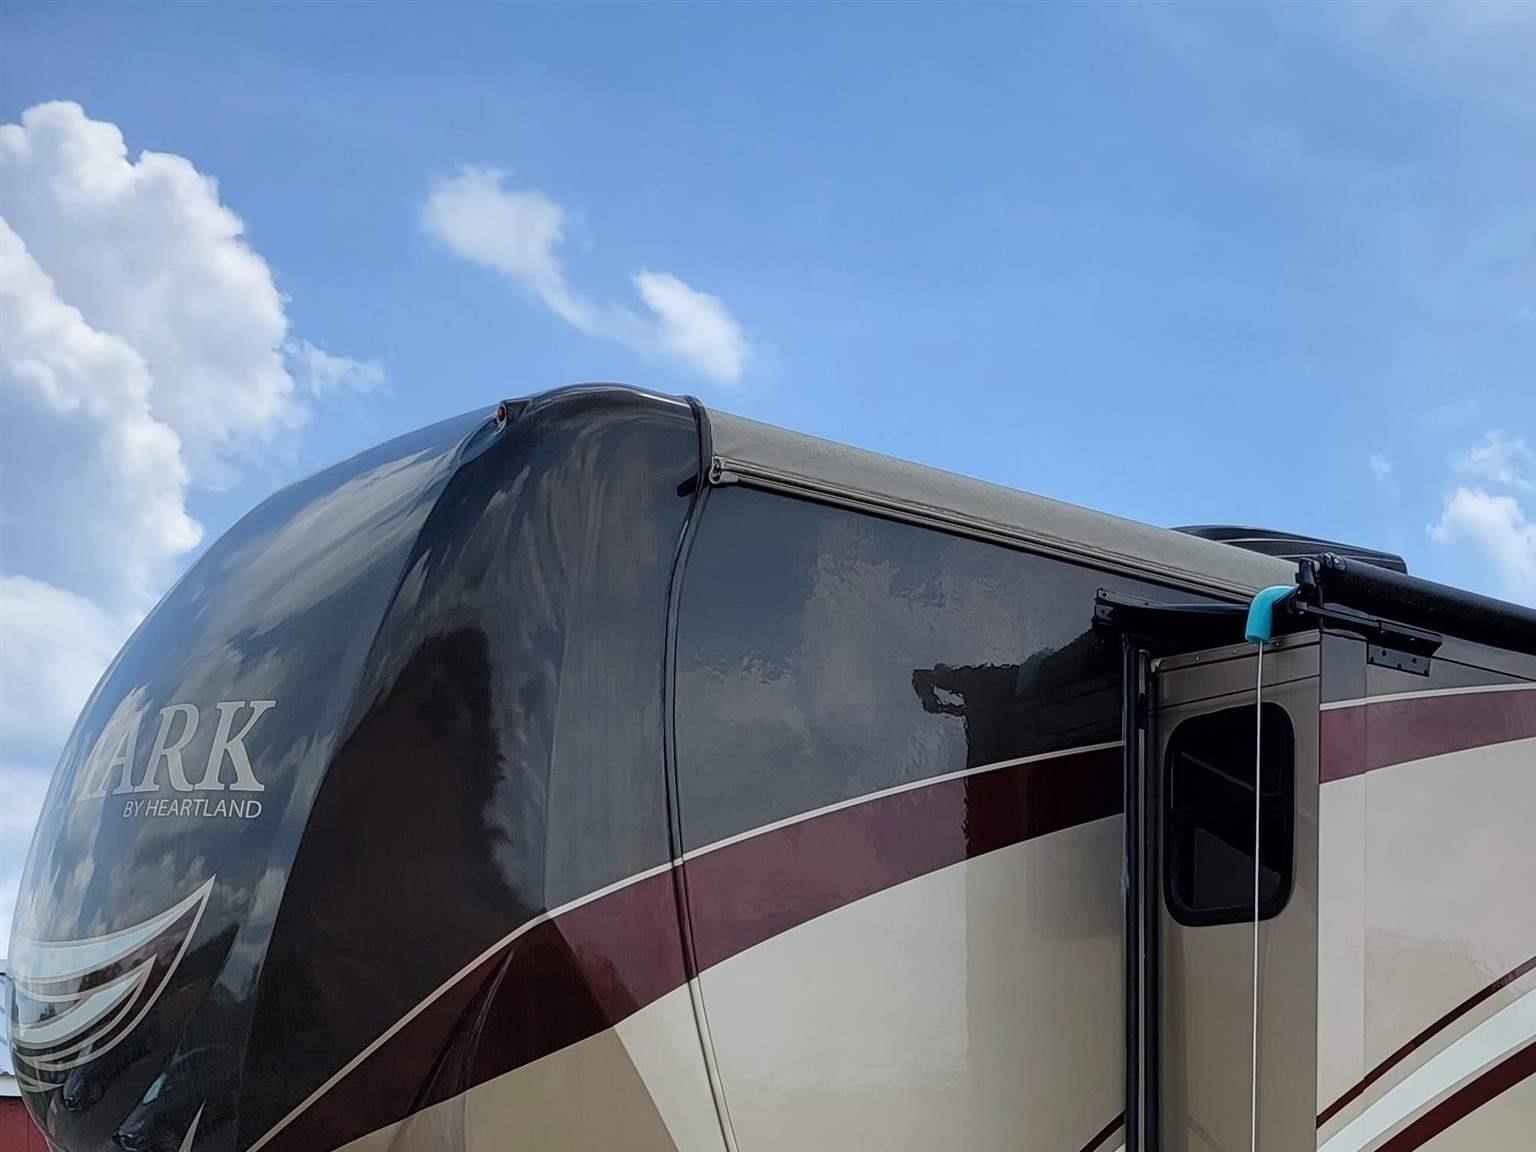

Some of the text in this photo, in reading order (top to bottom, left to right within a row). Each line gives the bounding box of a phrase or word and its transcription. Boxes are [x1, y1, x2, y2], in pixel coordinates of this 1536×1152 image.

[77, 699, 277, 801] ARK
[123, 799, 262, 819] BY HEARTLAND
